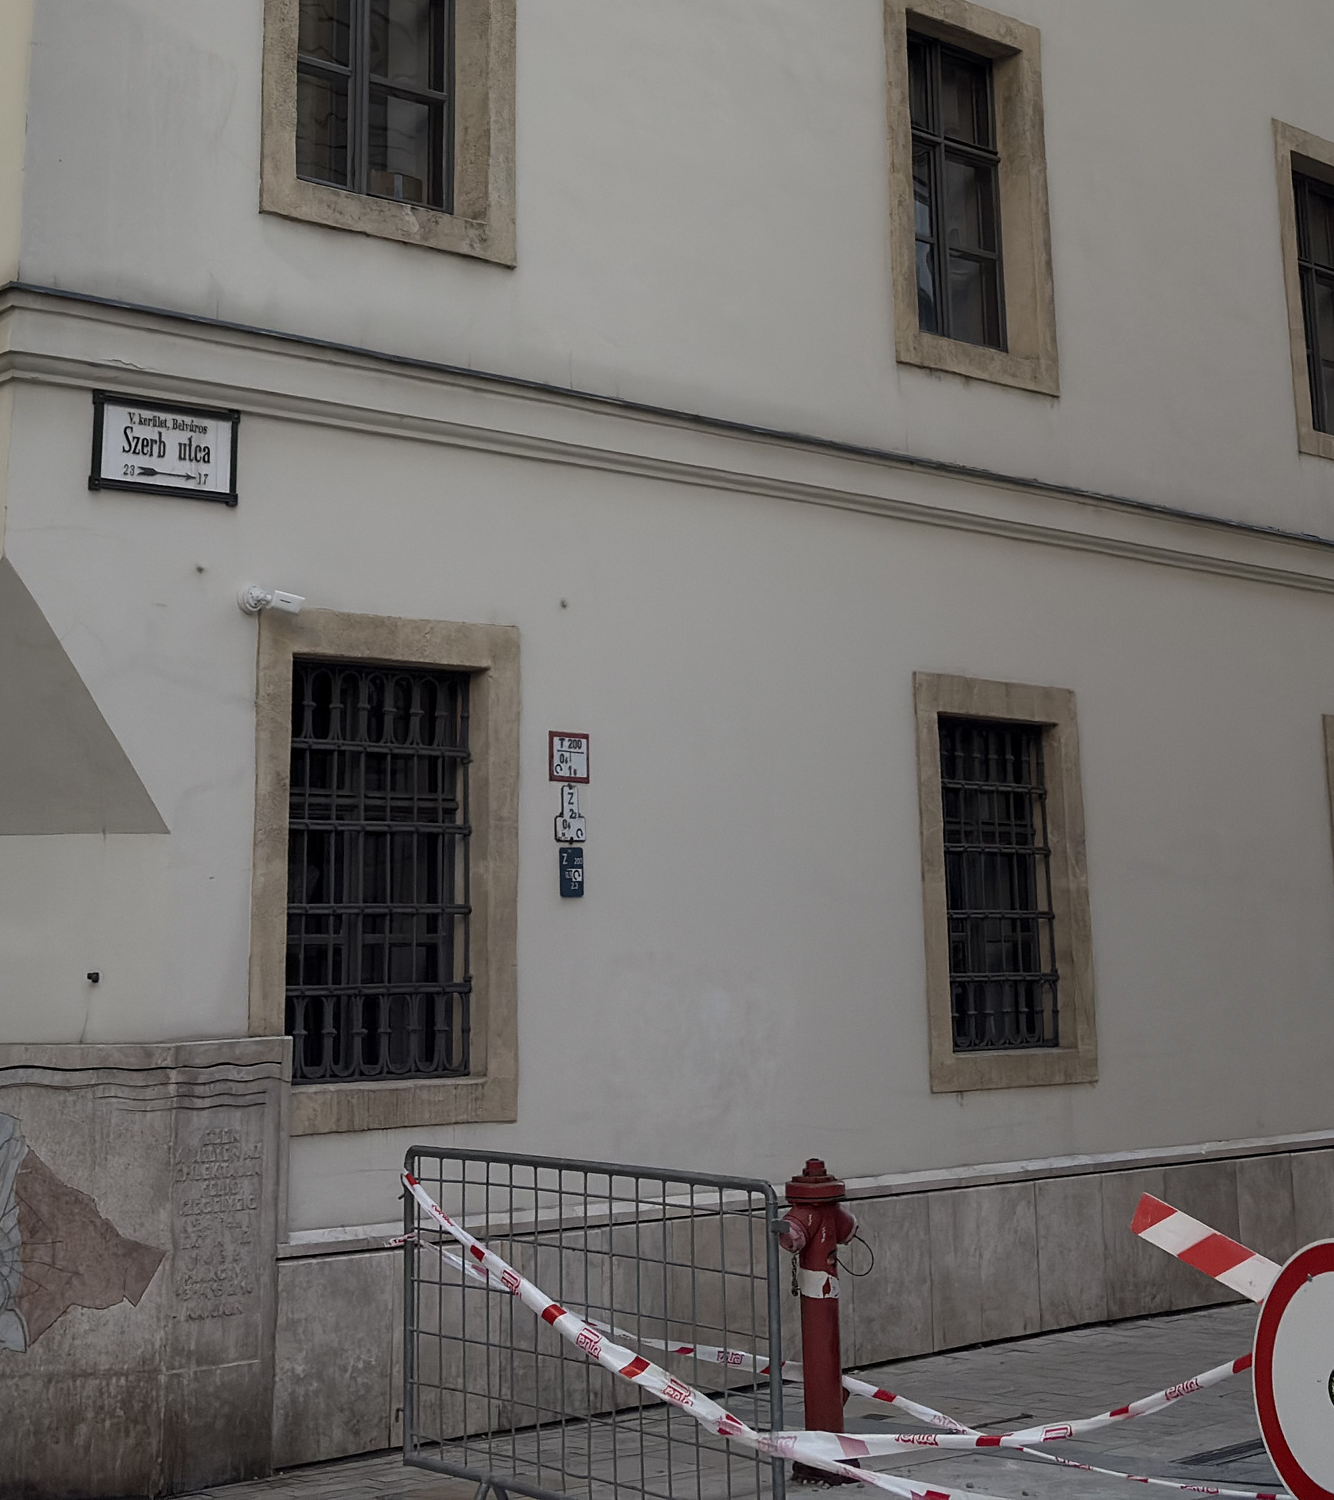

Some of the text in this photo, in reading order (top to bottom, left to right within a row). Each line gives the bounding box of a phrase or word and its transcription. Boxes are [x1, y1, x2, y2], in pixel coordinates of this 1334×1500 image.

[128, 412, 208, 434] V. kerület, Belváros
[122, 426, 211, 463] Szerb utca
[123, 464, 209, 485] 23 17
[558, 738, 583, 750] T 200
[568, 792, 574, 805] Z
[562, 854, 568, 865] Z
